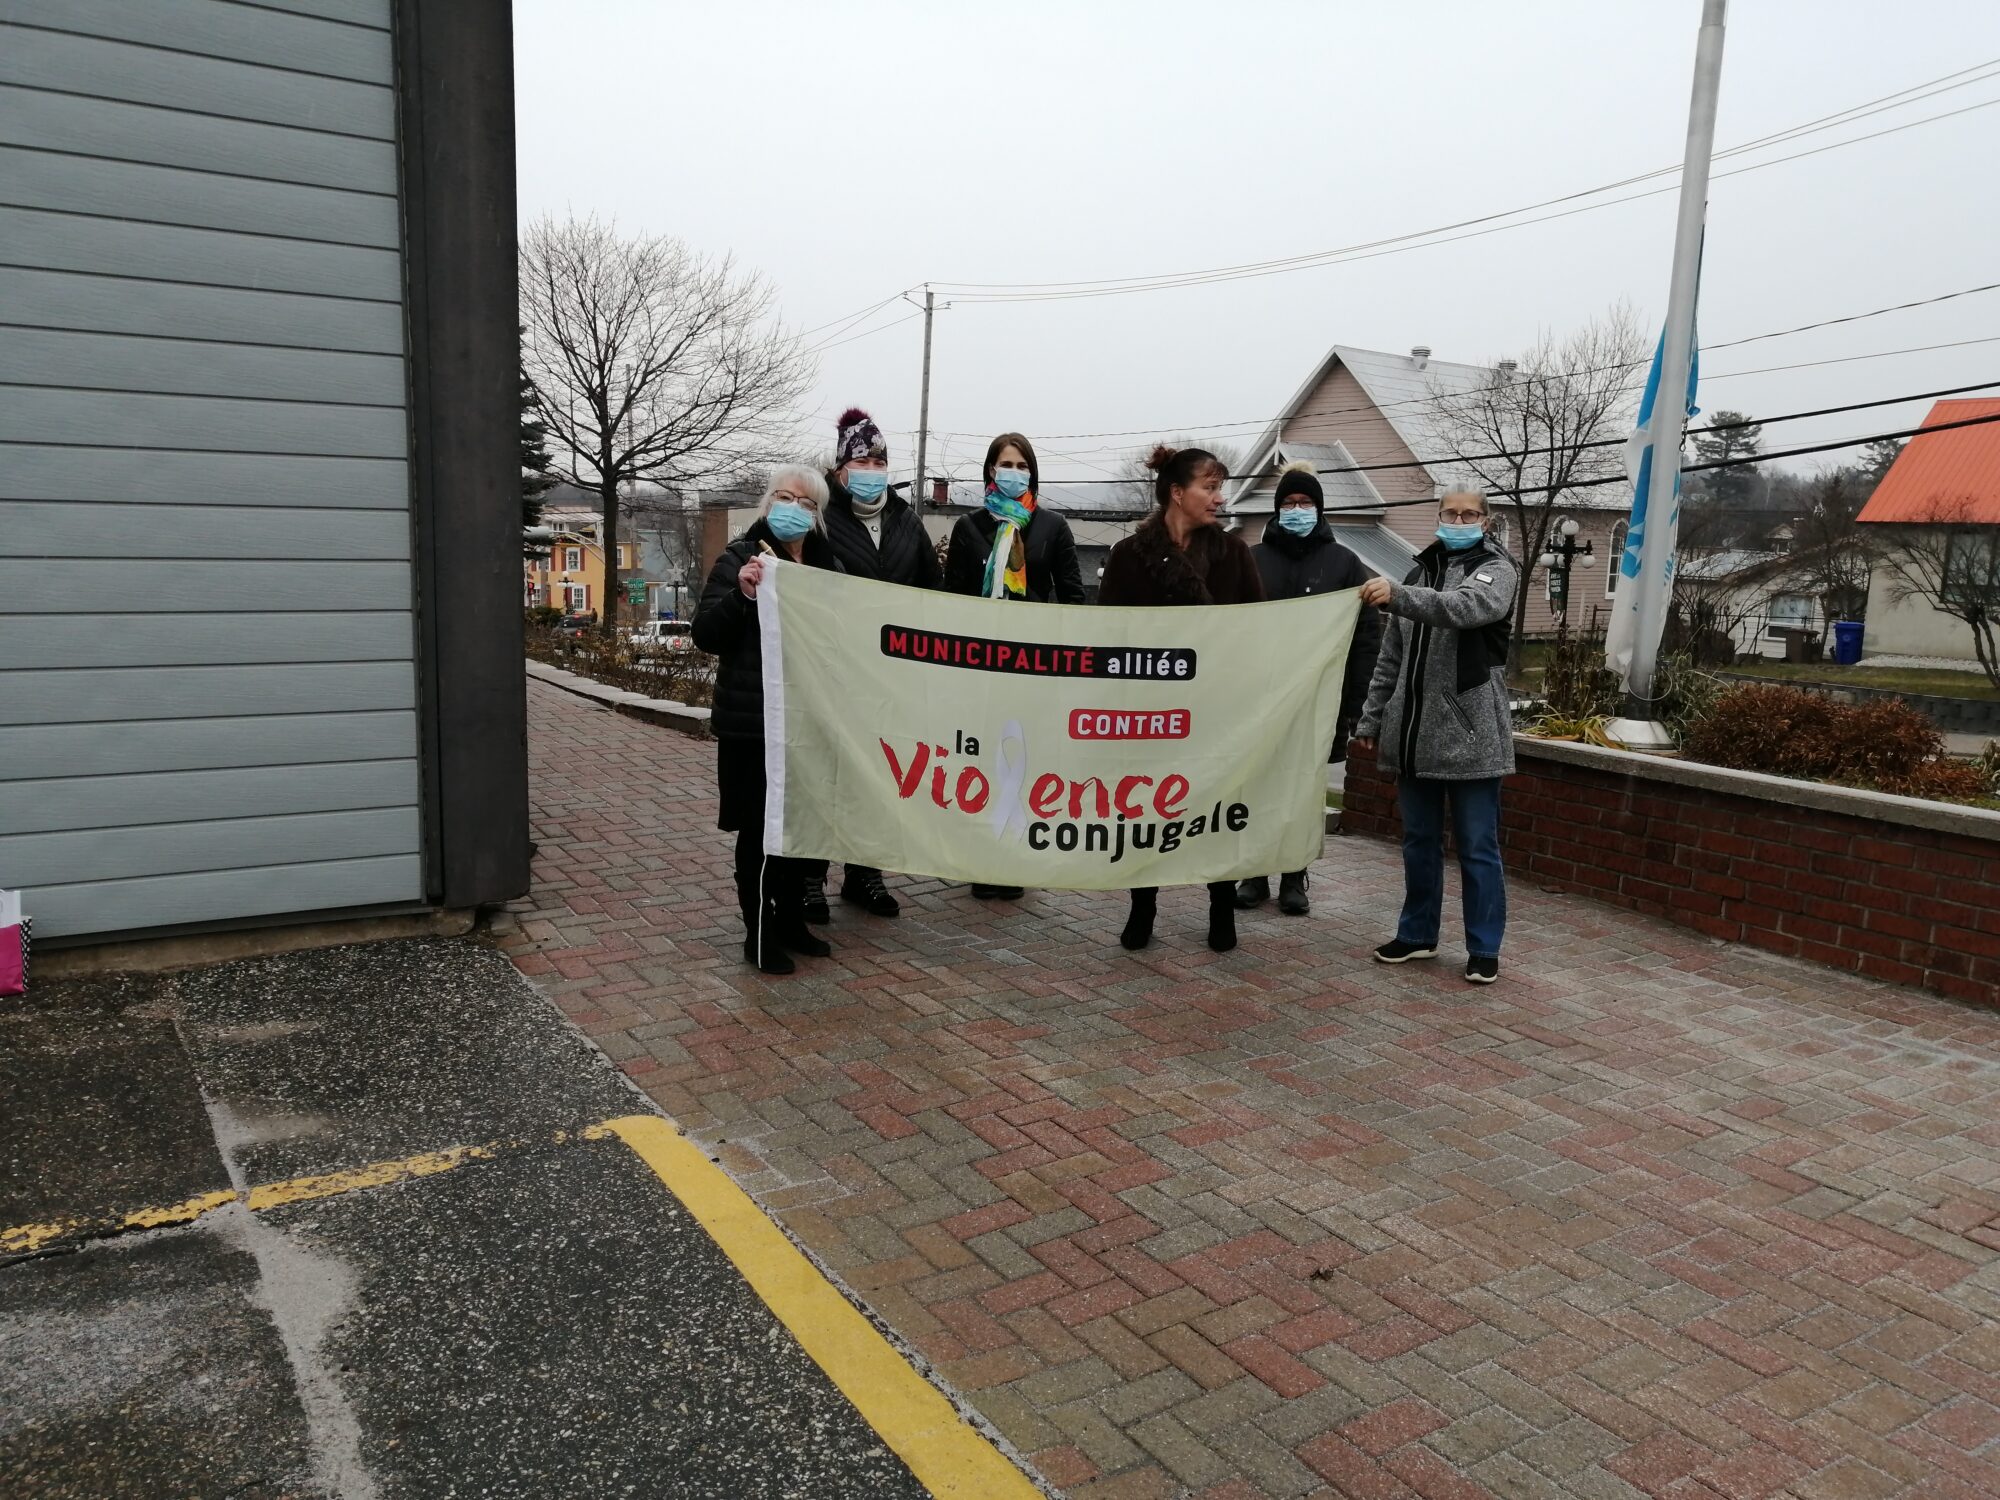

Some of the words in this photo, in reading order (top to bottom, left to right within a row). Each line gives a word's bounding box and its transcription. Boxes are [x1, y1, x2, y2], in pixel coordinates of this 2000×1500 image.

[889, 630, 1093, 673] MUNICIPALITÉ
[1107, 652, 1188, 676] alliée
[1077, 714, 1183, 735] CONTRE
[955, 730, 980, 756] la
[1028, 800, 1249, 863] conjugale
